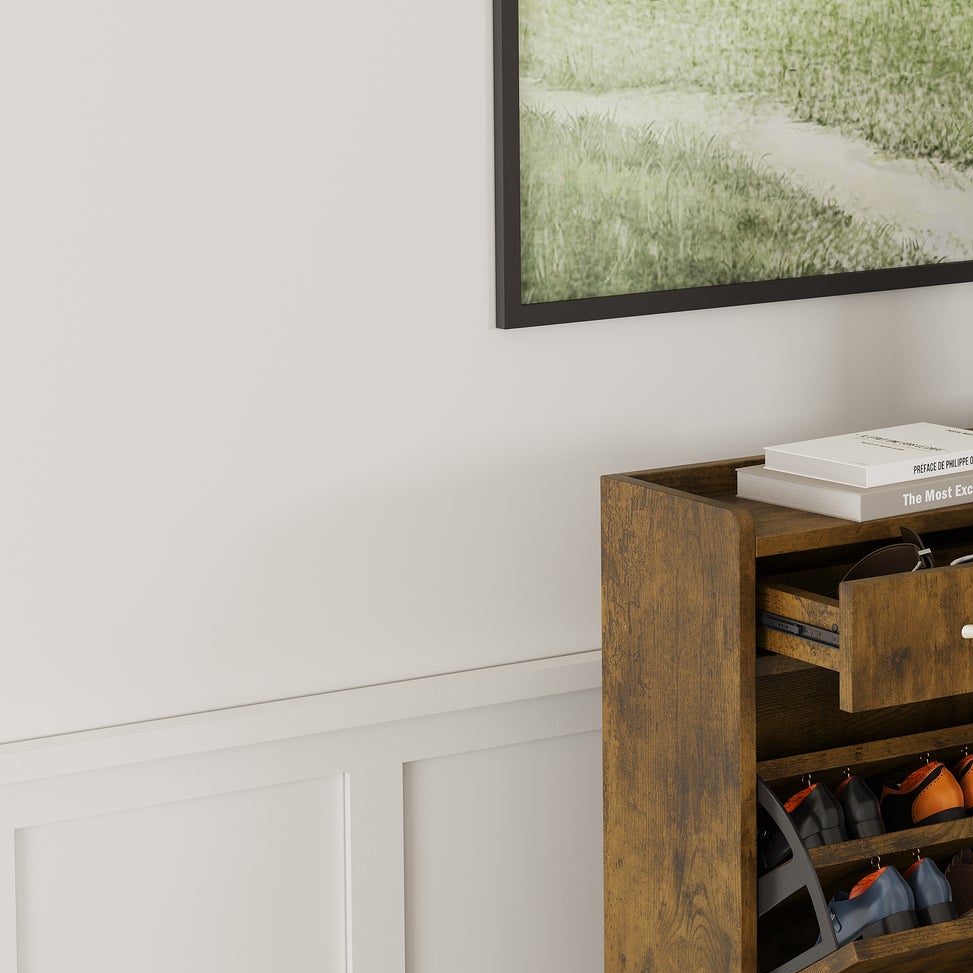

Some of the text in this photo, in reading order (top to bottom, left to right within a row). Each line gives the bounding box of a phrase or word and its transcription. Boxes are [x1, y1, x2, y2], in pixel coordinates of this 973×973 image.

[938, 461, 945, 470] DE
[946, 456, 969, 469] PHILIPPE
[903, 493, 922, 506] The
[925, 487, 952, 502] Most
